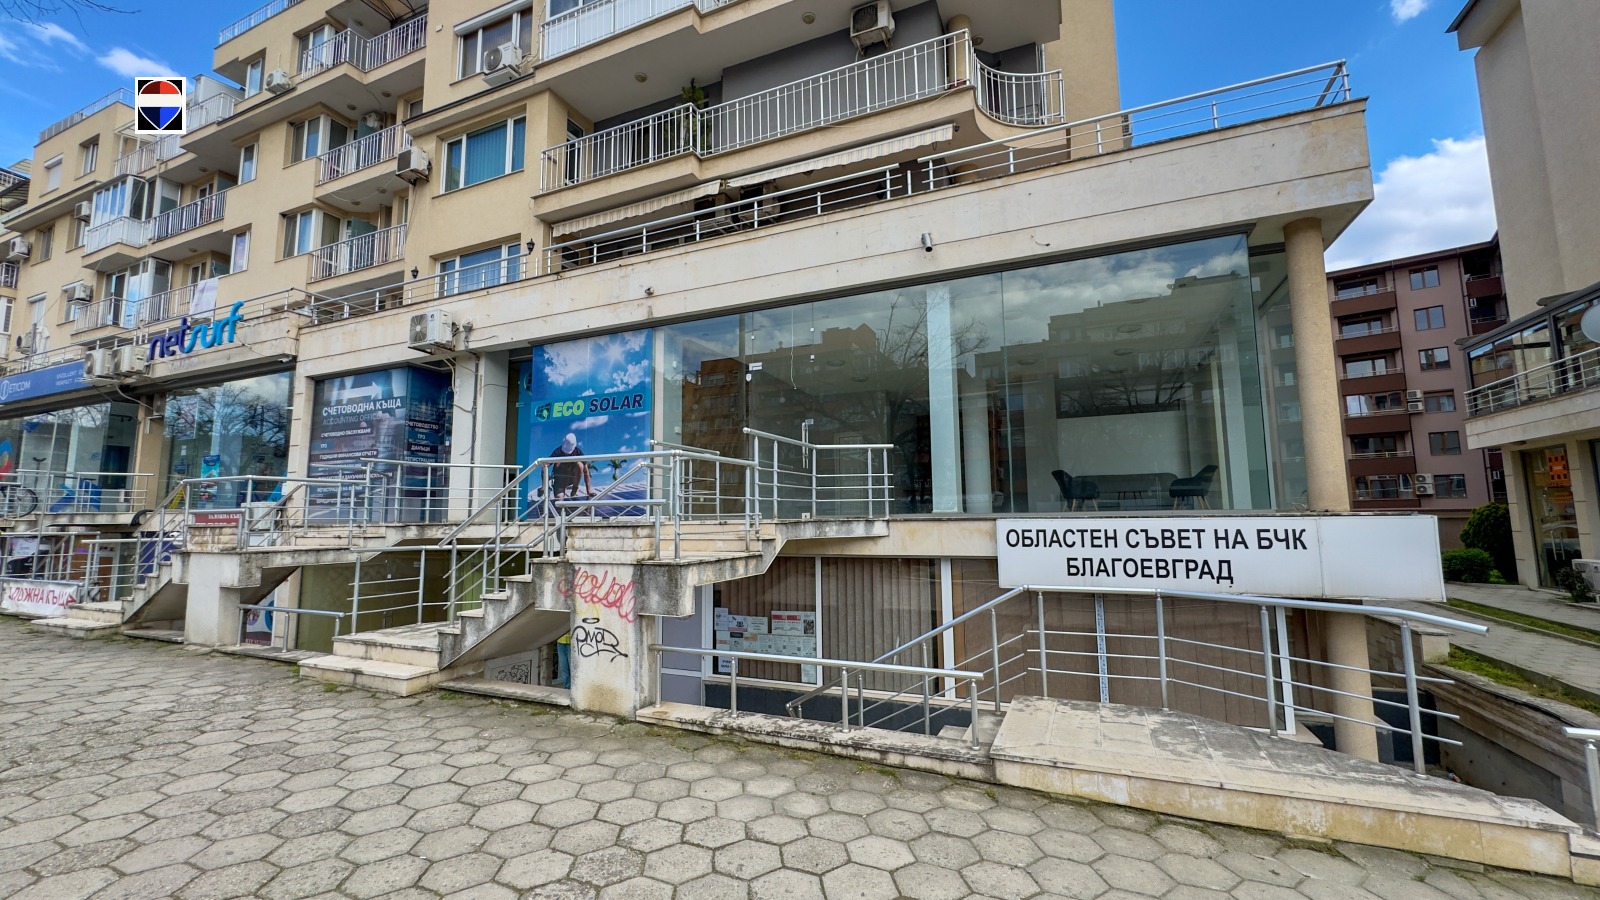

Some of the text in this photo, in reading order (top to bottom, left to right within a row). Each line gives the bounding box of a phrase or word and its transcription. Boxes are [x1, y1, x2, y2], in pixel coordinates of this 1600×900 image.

[147, 301, 244, 361] netsurf
[322, 398, 401, 416] СЧЕТОВОДНА КЪЩА
[553, 394, 643, 417] ECO SOLAR
[323, 415, 359, 426] ACCOUNTING
[1006, 528, 1308, 550] ОБЛАСТЕН СЪВЕТ НА БЧК
[1066, 557, 1234, 584] БЛАГОЕВГРАД
